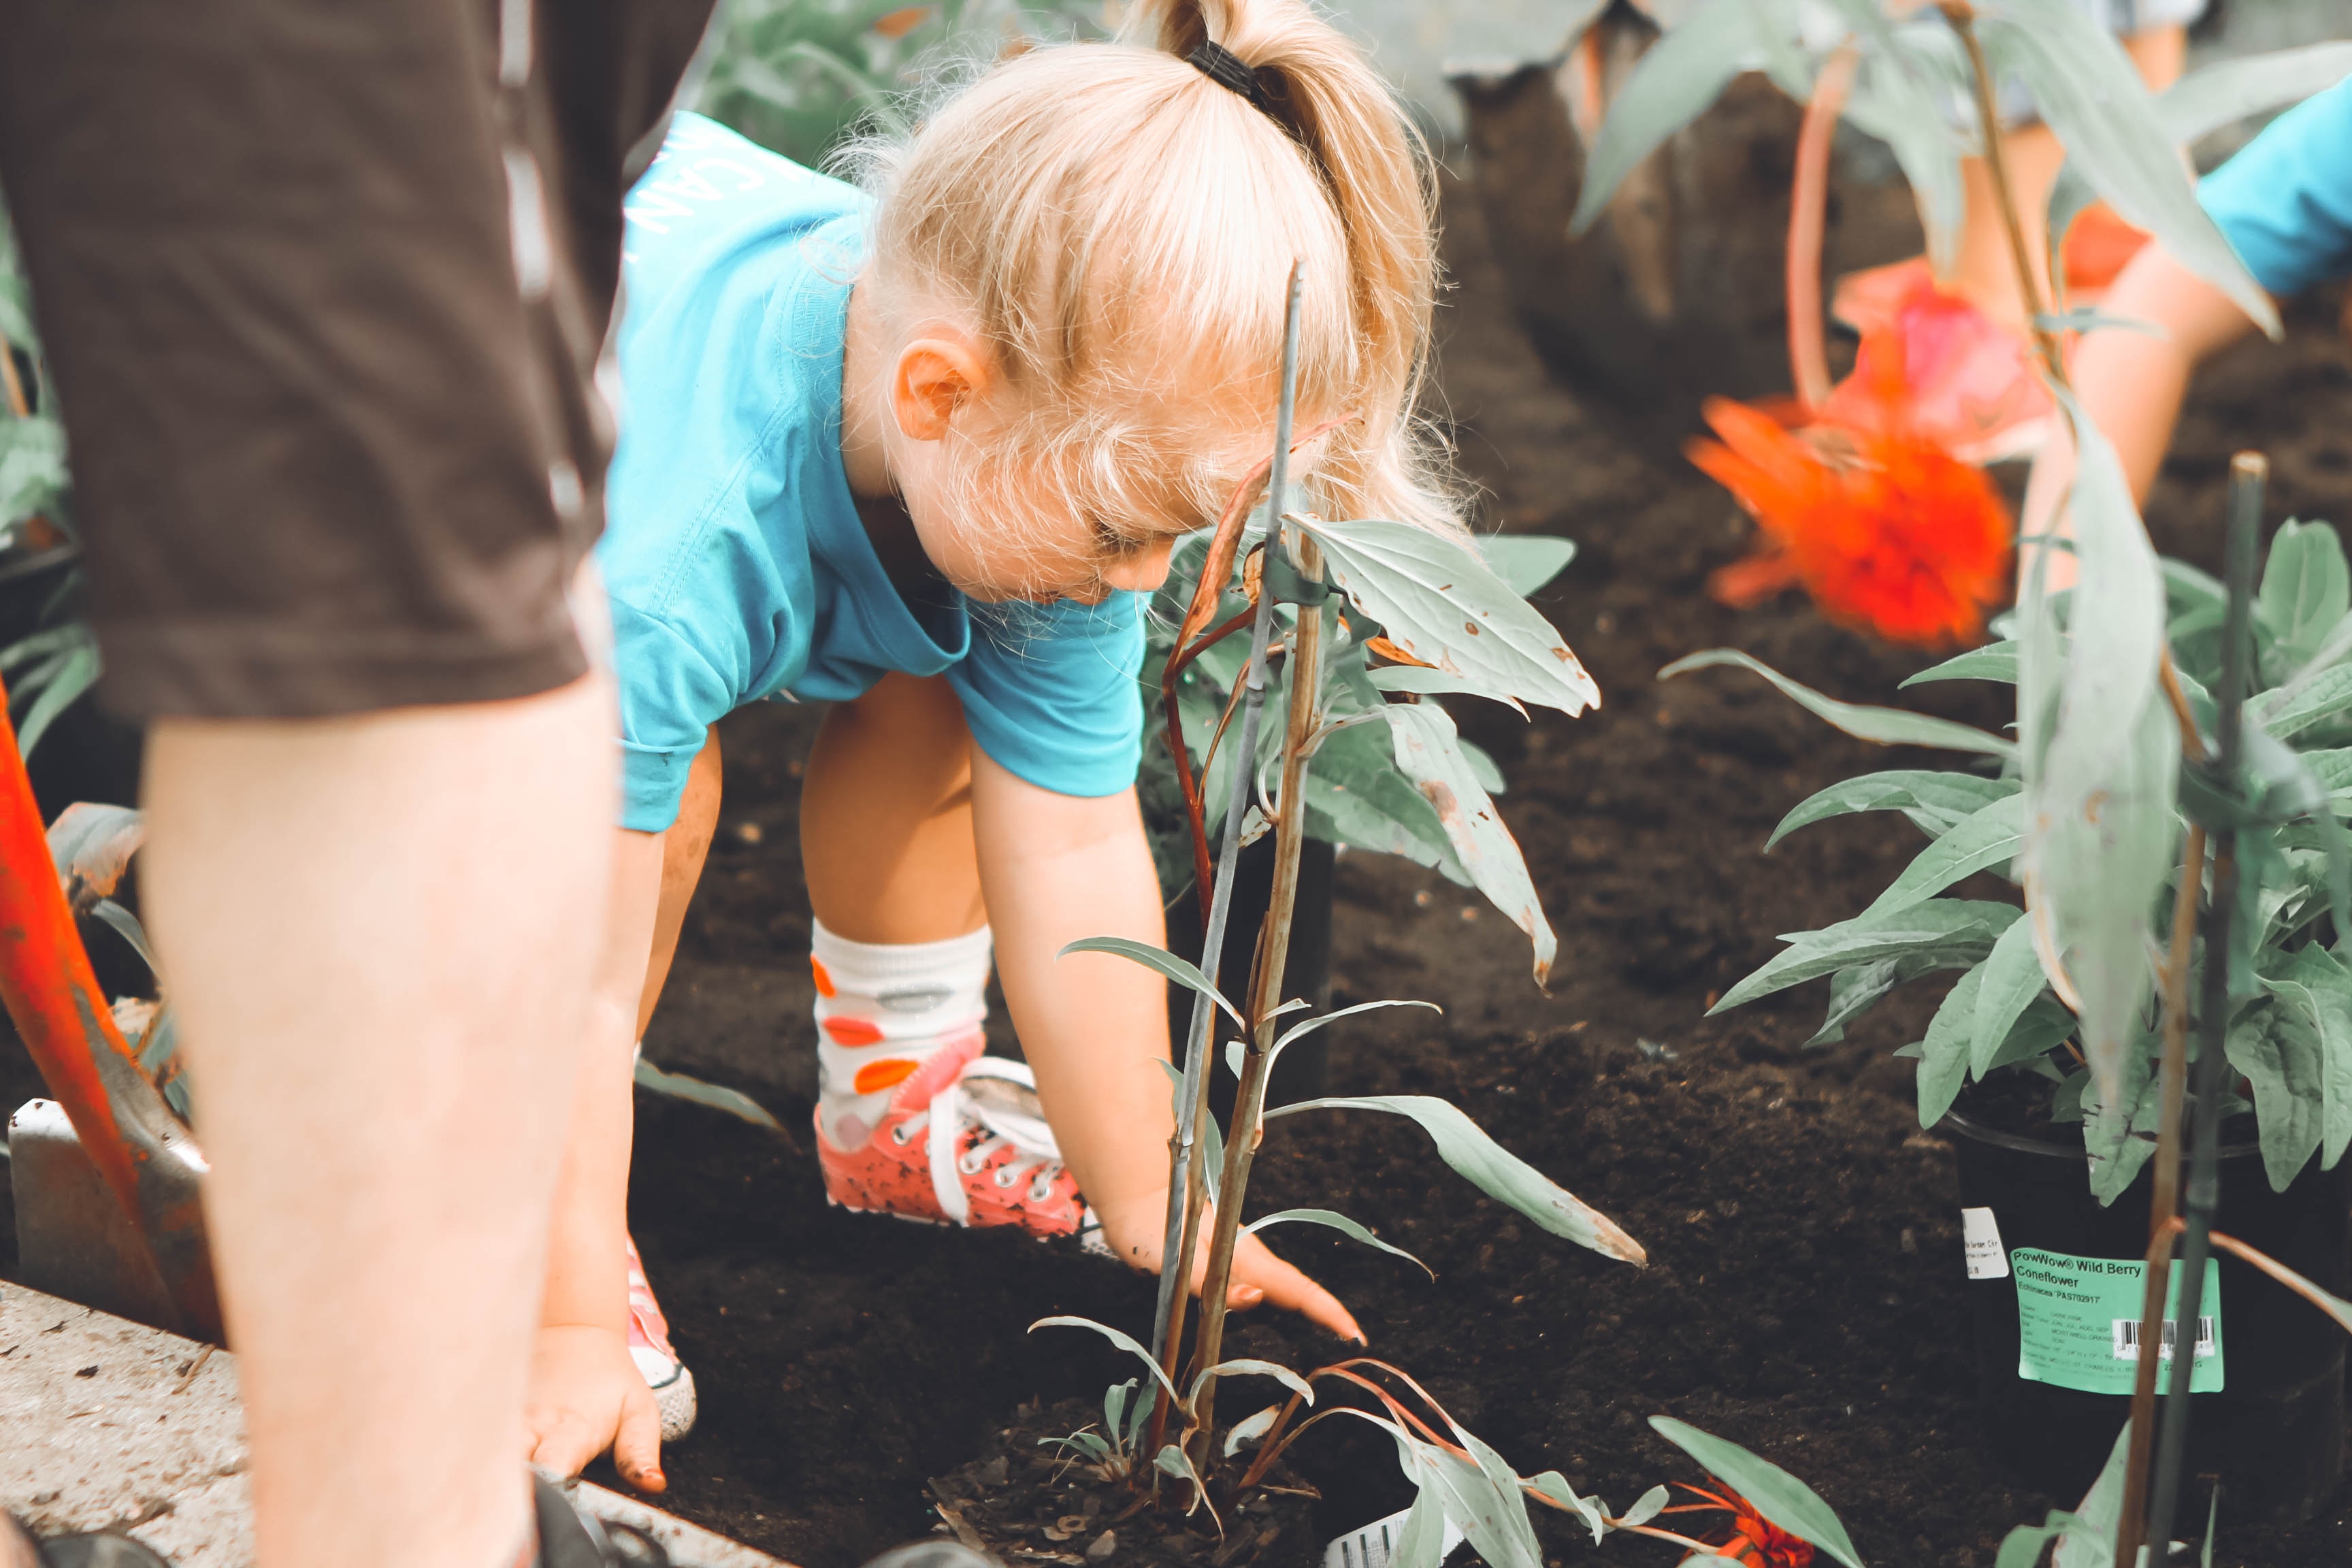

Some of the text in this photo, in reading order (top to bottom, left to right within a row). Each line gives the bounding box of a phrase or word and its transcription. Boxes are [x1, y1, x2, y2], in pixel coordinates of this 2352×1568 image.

[2016, 1266, 2078, 1288] Coneflower
[2076, 1260, 2103, 1273] Wild
[2107, 1263, 2141, 1277] Berry
[2018, 1281, 2053, 1297] Echinacea
